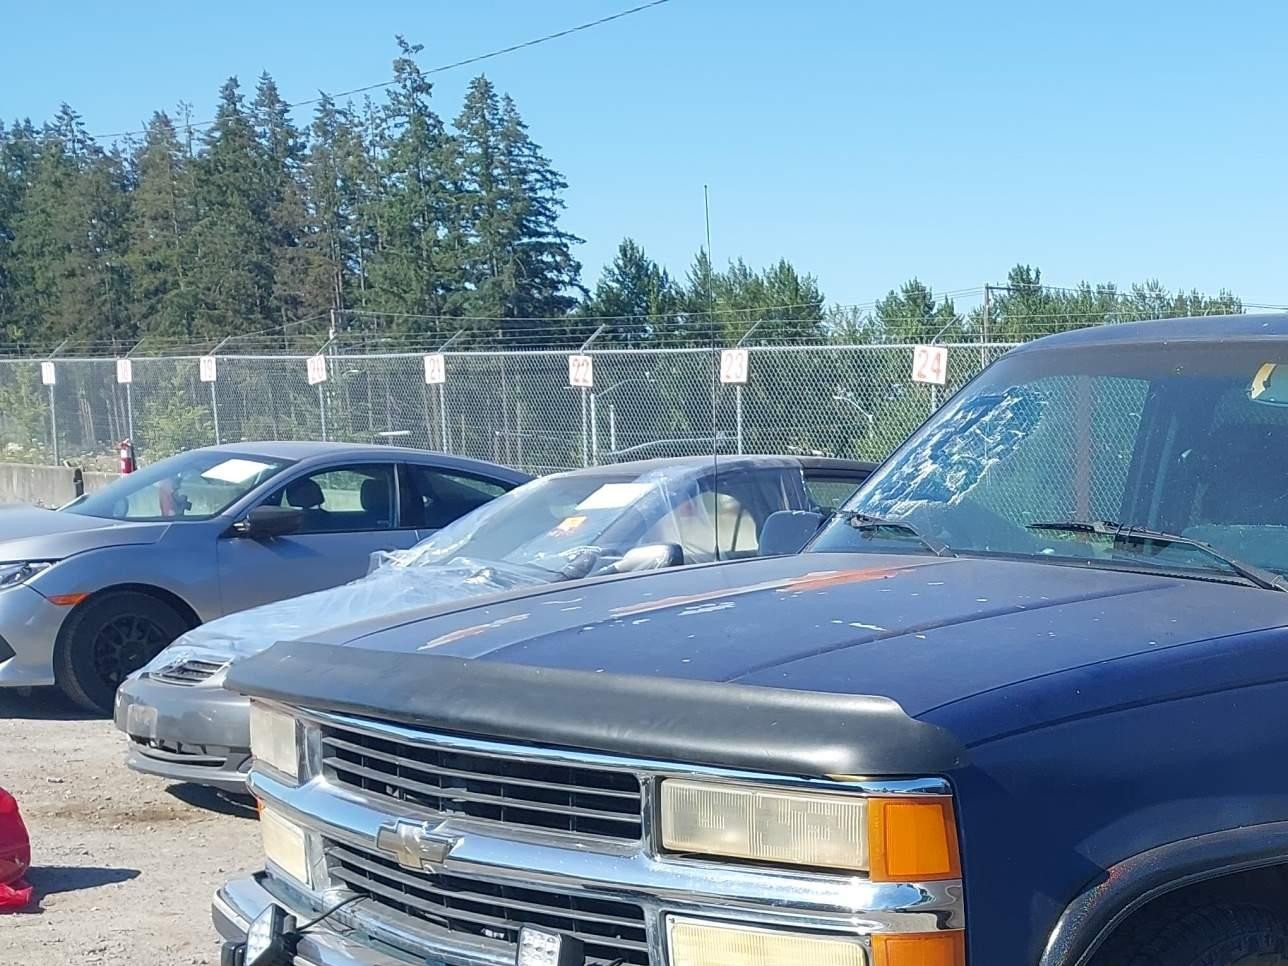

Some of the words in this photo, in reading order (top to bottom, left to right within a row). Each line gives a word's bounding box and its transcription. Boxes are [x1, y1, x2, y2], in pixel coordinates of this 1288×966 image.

[309, 357, 324, 382] 20
[429, 358, 442, 381] 21
[572, 357, 590, 384] 22
[724, 352, 744, 380] 23
[916, 349, 942, 380] 24
